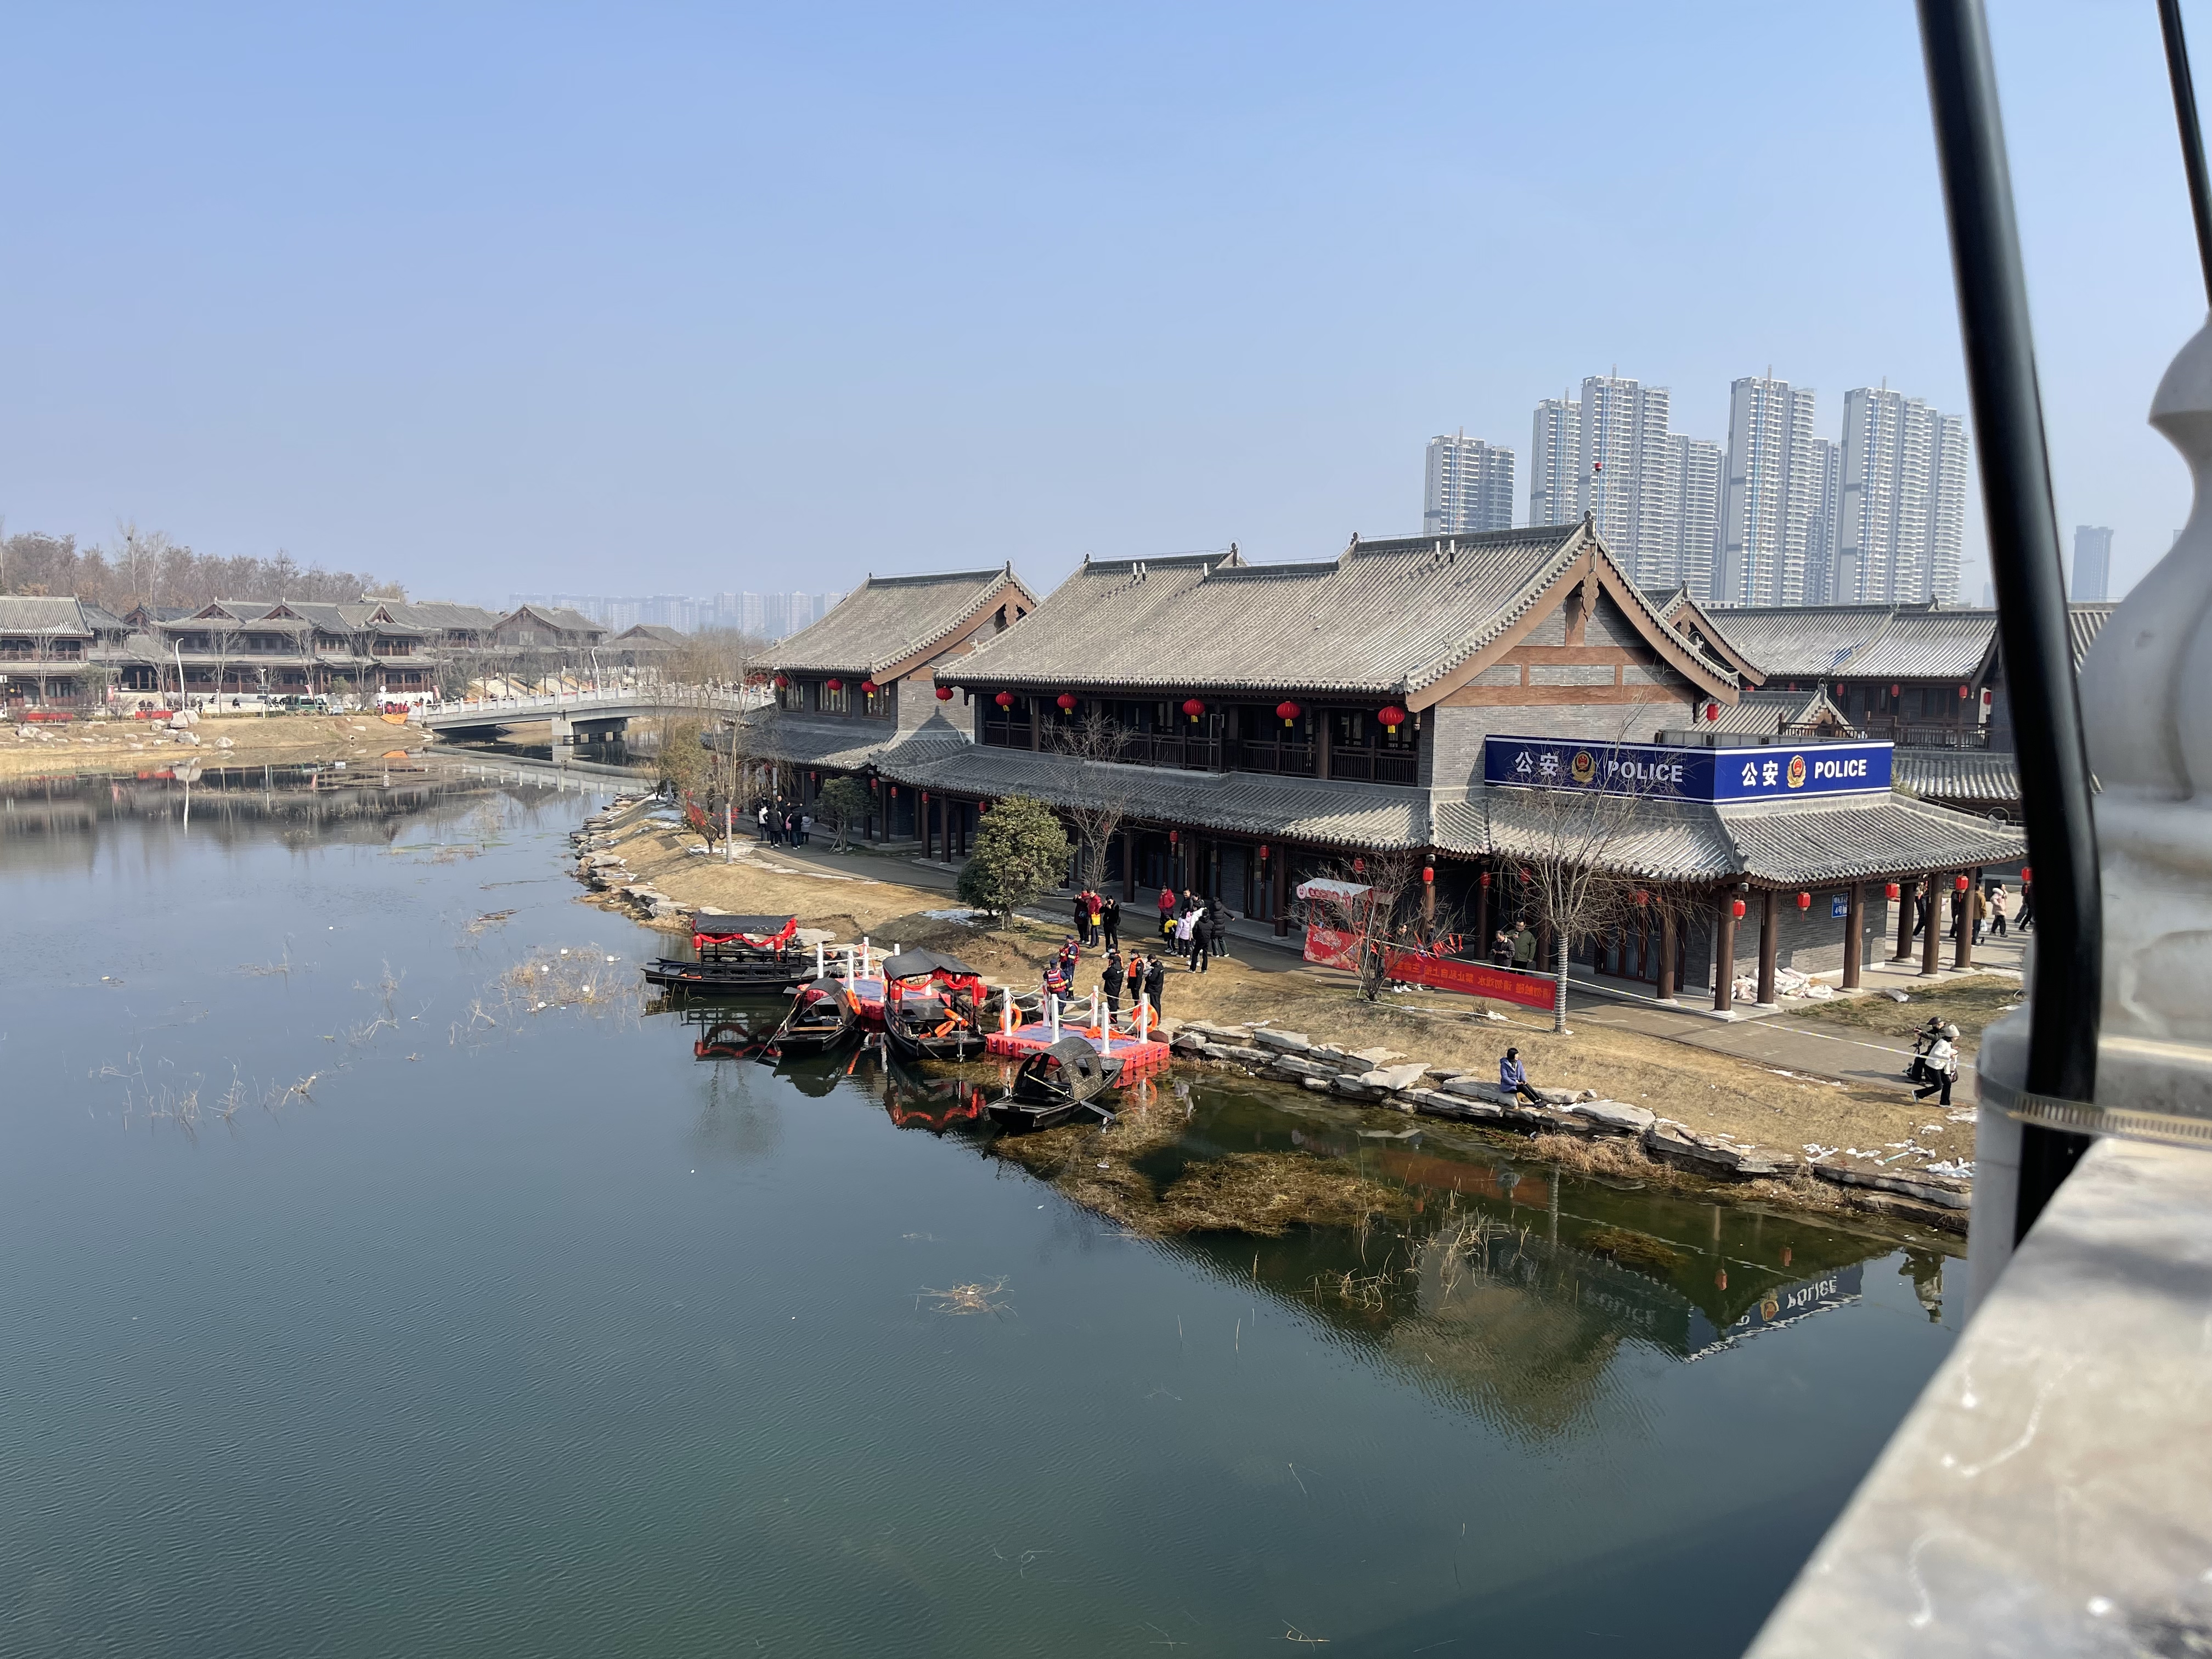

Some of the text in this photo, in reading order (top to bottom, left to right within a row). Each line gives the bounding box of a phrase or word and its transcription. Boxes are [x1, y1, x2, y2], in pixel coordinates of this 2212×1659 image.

[1515, 752, 1683, 782] 公安 POLICE
[1741, 759, 1867, 787] 公安 POLICE
